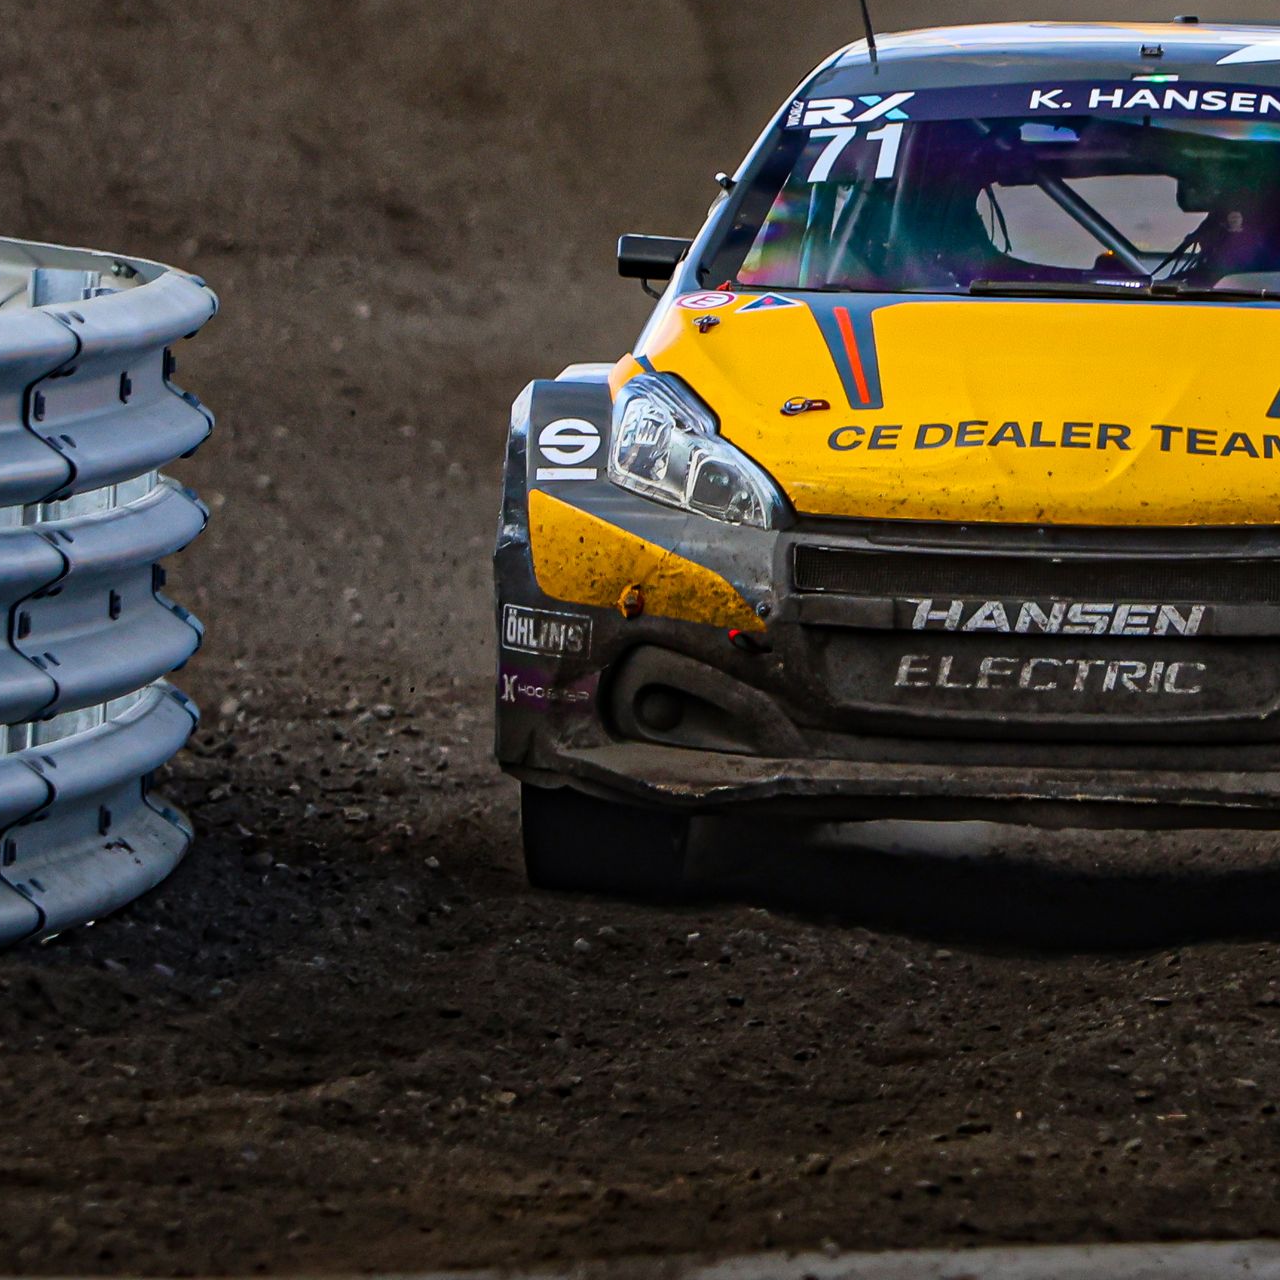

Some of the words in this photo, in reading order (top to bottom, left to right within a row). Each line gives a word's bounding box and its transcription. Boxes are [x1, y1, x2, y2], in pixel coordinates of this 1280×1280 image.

[803, 91, 916, 126] RX
[1029, 88, 1072, 110] K.
[807, 122, 904, 183] 71
[827, 424, 903, 451] CE
[913, 420, 1133, 451] DEALER
[904, 597, 1207, 637] HANSEN
[893, 654, 1208, 695] ELECTRIC
